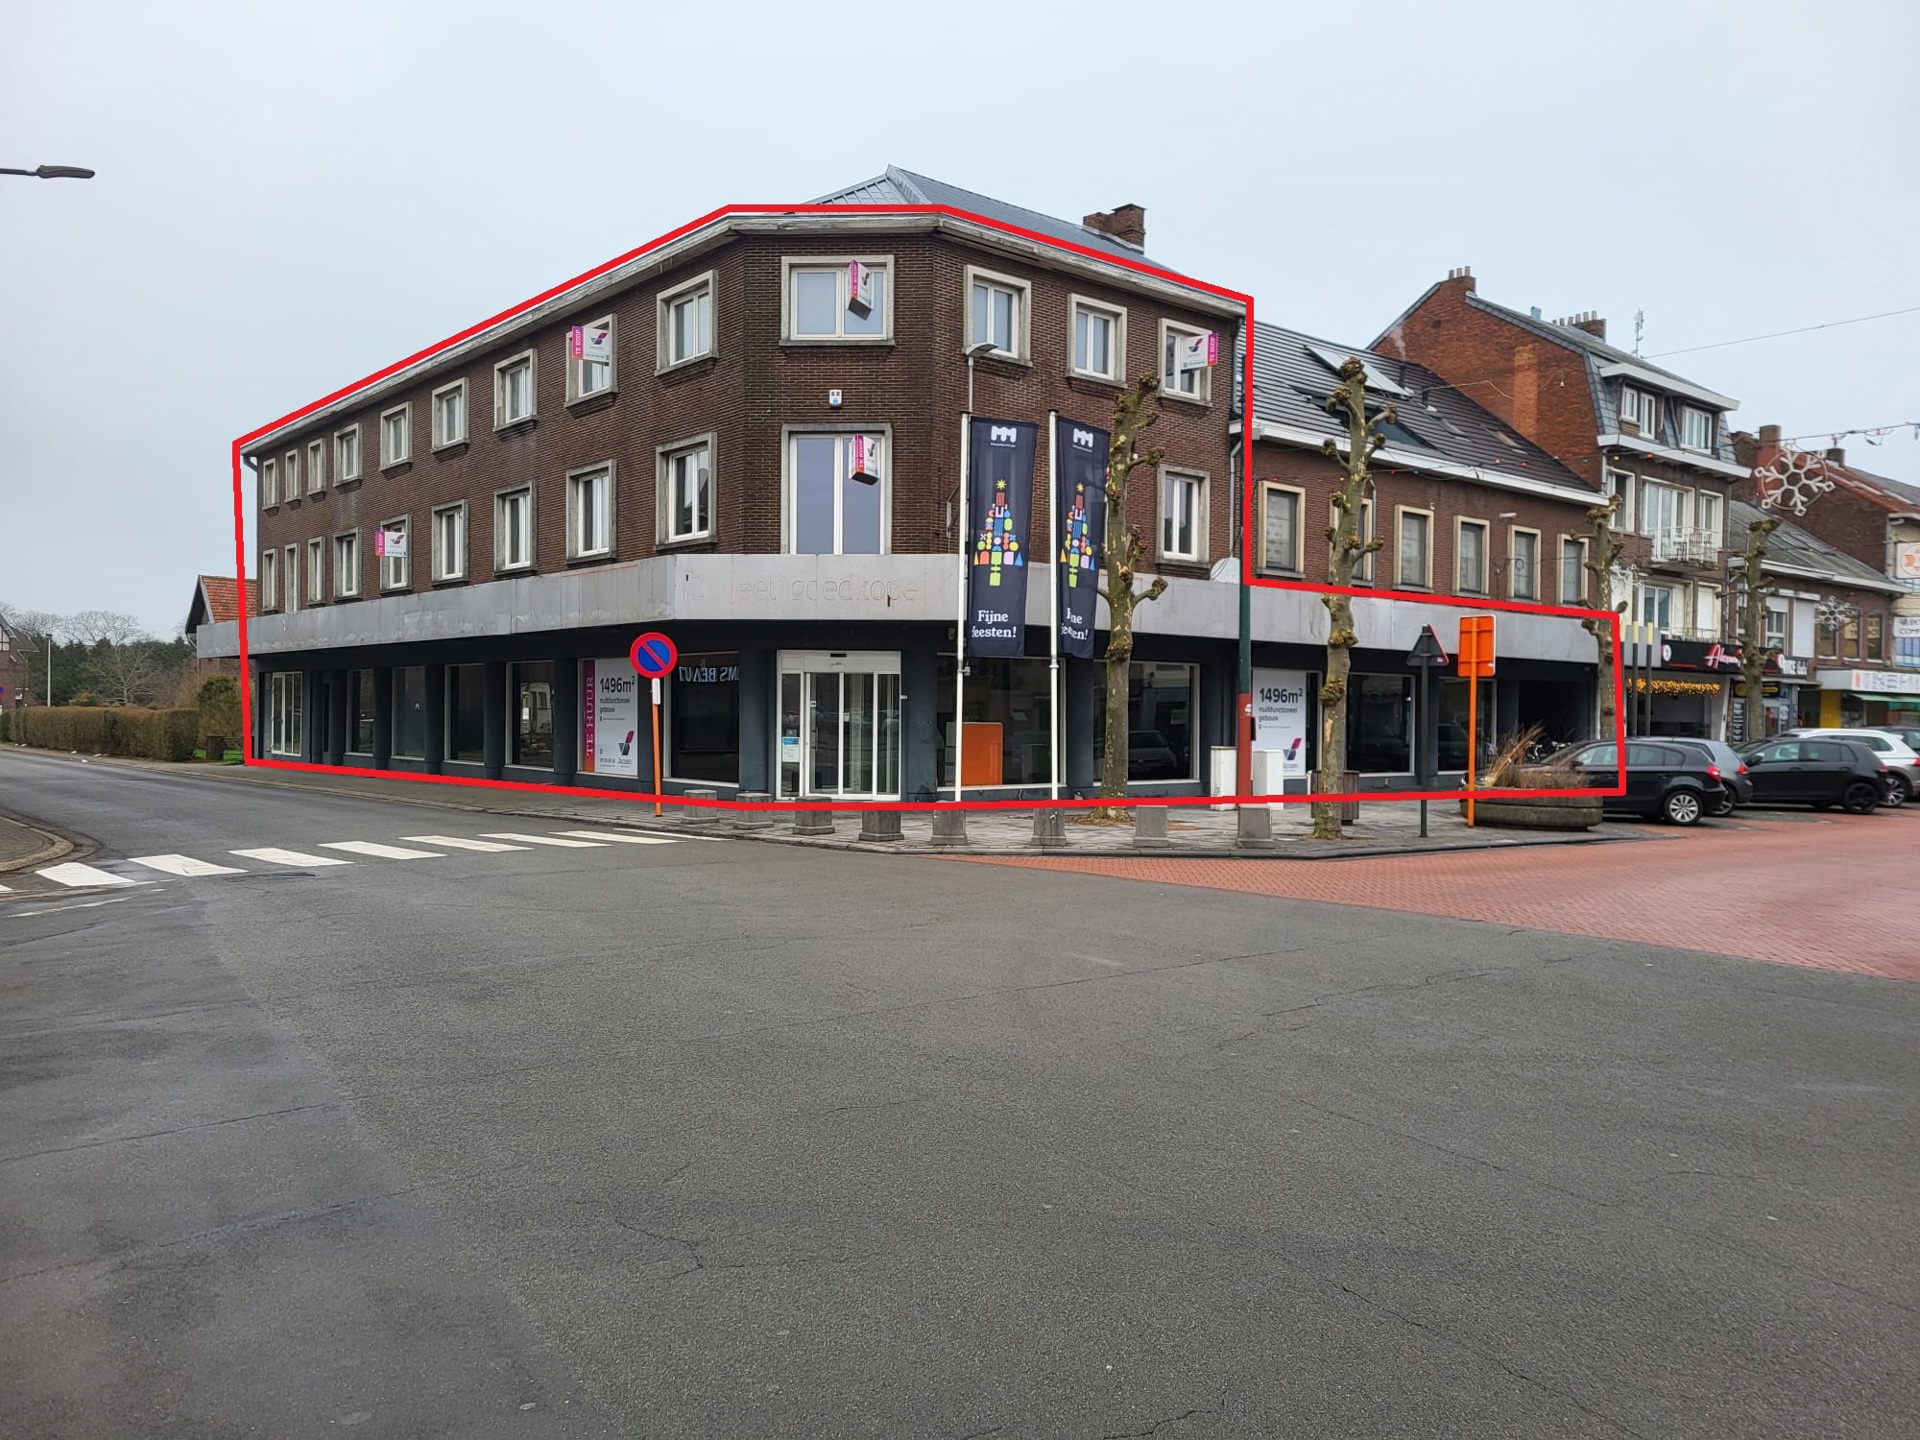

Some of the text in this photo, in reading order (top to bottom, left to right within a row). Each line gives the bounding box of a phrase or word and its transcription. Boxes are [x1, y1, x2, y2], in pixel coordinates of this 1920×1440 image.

[977, 609, 1009, 625] Fijne
[599, 675, 636, 693] 1496m²
[1259, 687, 1304, 703] 1496m²
[586, 676, 594, 757] TE HUUR
